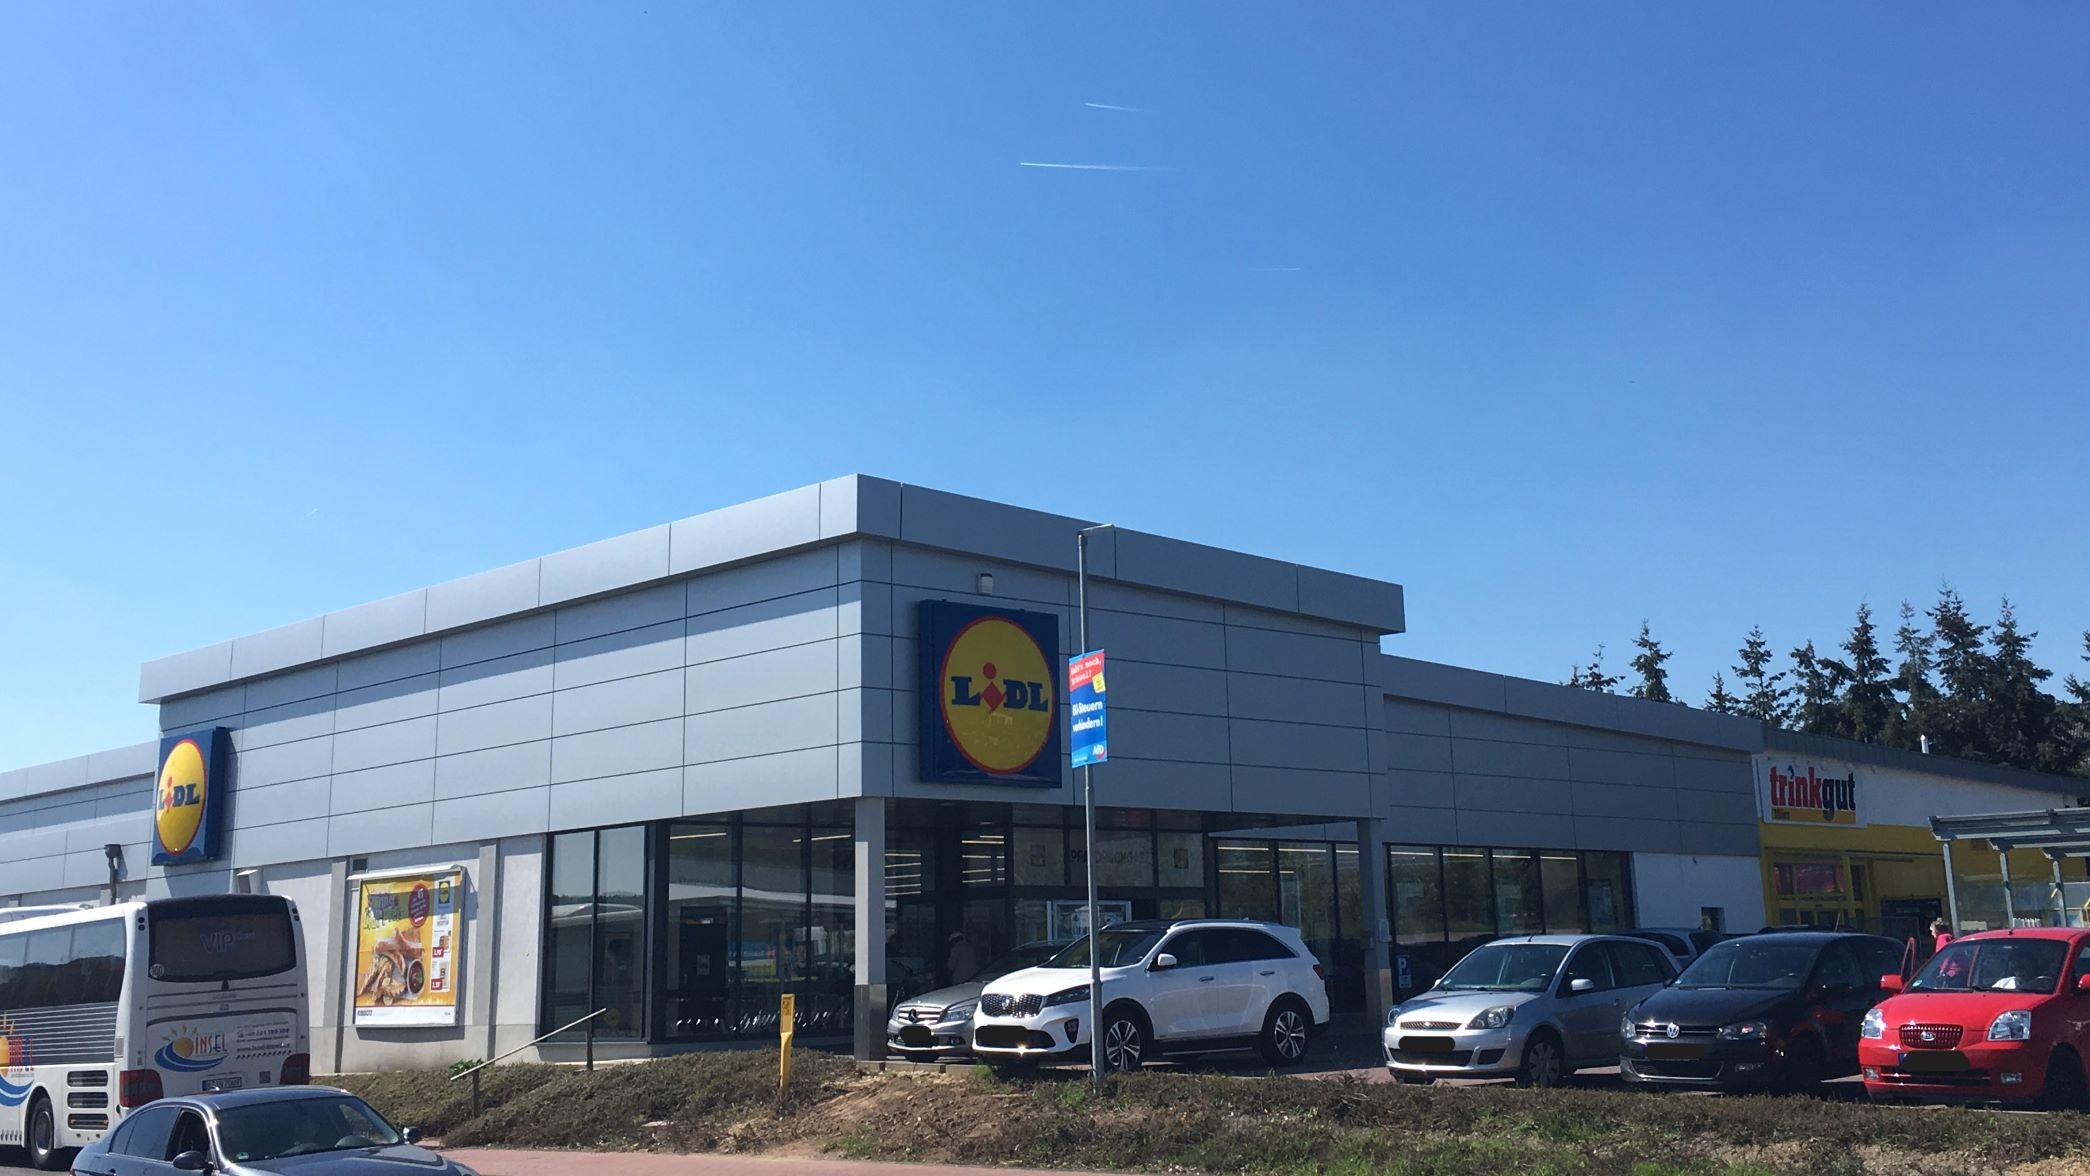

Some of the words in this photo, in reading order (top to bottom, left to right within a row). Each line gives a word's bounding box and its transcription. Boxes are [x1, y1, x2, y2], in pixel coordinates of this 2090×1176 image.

[951, 662, 1049, 713] LIDL
[1092, 744, 1105, 756] AfD
[157, 775, 201, 814] LIDL
[1769, 764, 1856, 822] trinkgut
[199, 930, 234, 954] VIP
[1397, 958, 1407, 976] P
[193, 1032, 228, 1056] INSEL
